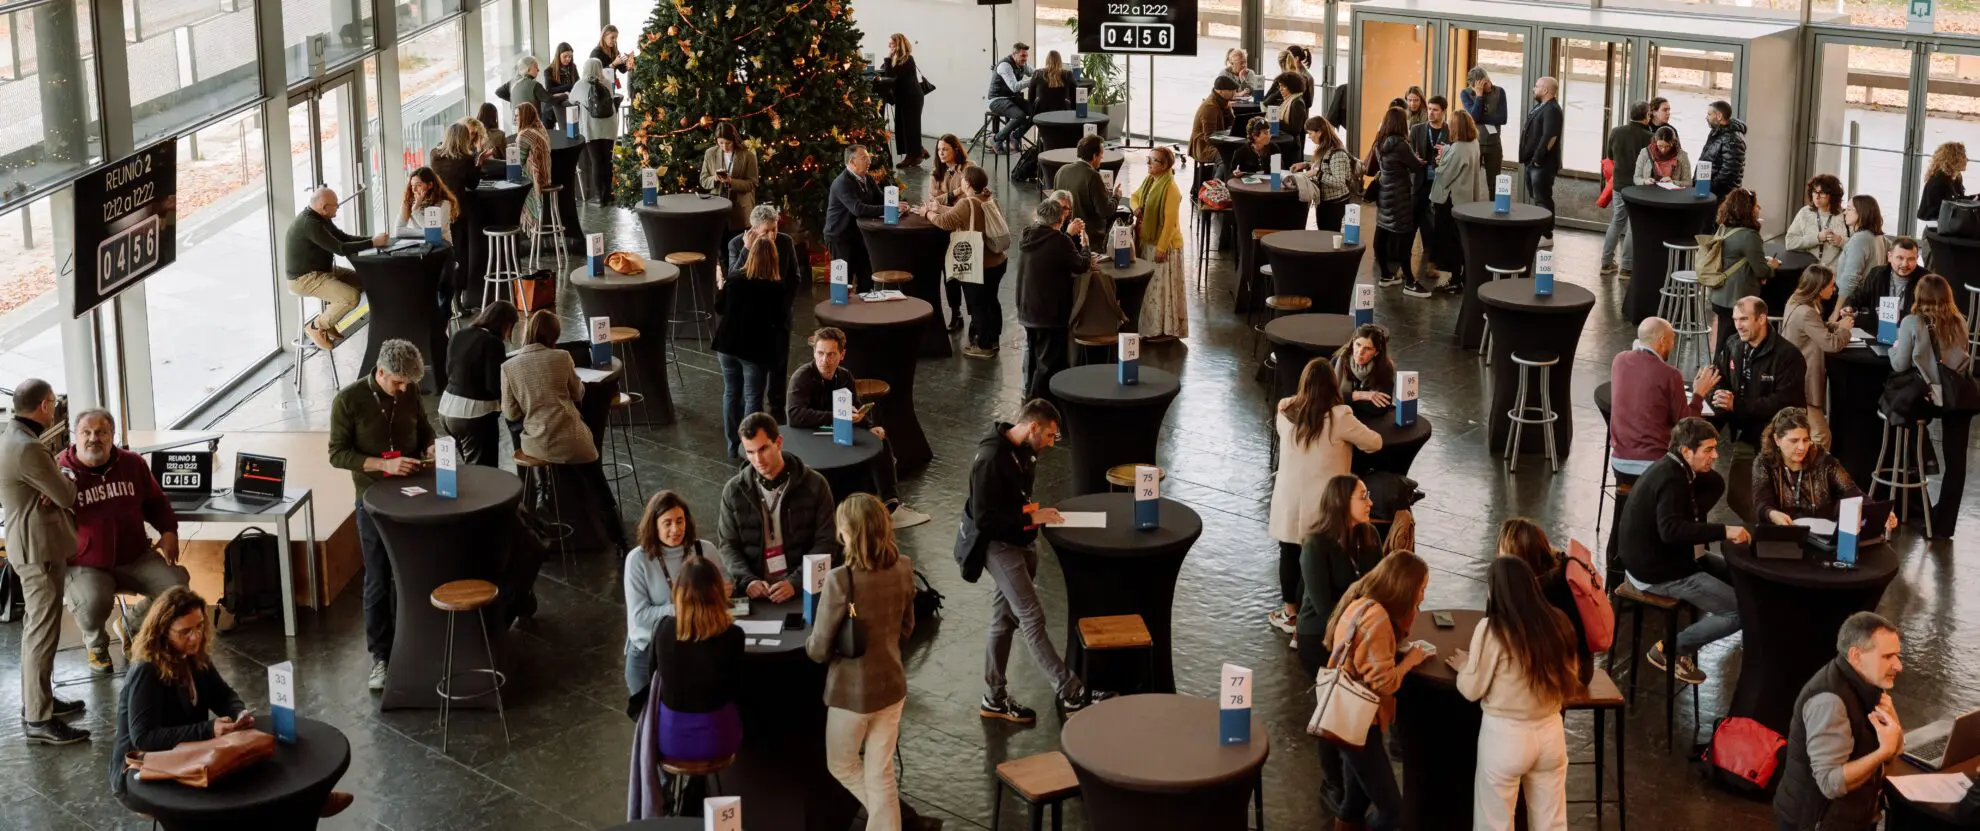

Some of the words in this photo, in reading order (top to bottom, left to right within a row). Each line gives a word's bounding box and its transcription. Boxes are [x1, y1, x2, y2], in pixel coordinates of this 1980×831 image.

[1107, 3, 1130, 15] 12:12
[1131, 6, 1140, 15] a
[1142, 4, 1168, 16] 12:22
[106, 157, 142, 192] REUNIÓ
[145, 153, 152, 174] 2
[125, 196, 132, 212] a
[953, 263, 973, 272] PADI
[1882, 300, 1895, 309] 123
[1881, 312, 1894, 320] 124
[598, 321, 606, 330] 29
[598, 333, 607, 341] 30
[1127, 337, 1136, 346] 73
[1127, 349, 1136, 358] 74
[1407, 376, 1416, 385] 95
[1407, 390, 1415, 398] 96
[837, 395, 846, 404] 49
[837, 409, 847, 417] 50
[440, 443, 449, 453] 31
[168, 454, 191, 462] REUNIÓ
[440, 457, 450, 467] 32
[1143, 474, 1153, 483] 75
[77, 481, 136, 507] SAUSALITO
[1143, 488, 1153, 497] 76
[817, 561, 826, 573] 51
[274, 673, 287, 685] 33
[1230, 676, 1245, 687] 77
[275, 692, 287, 703] 34
[1230, 695, 1244, 705] 78
[721, 807, 735, 822] 53
